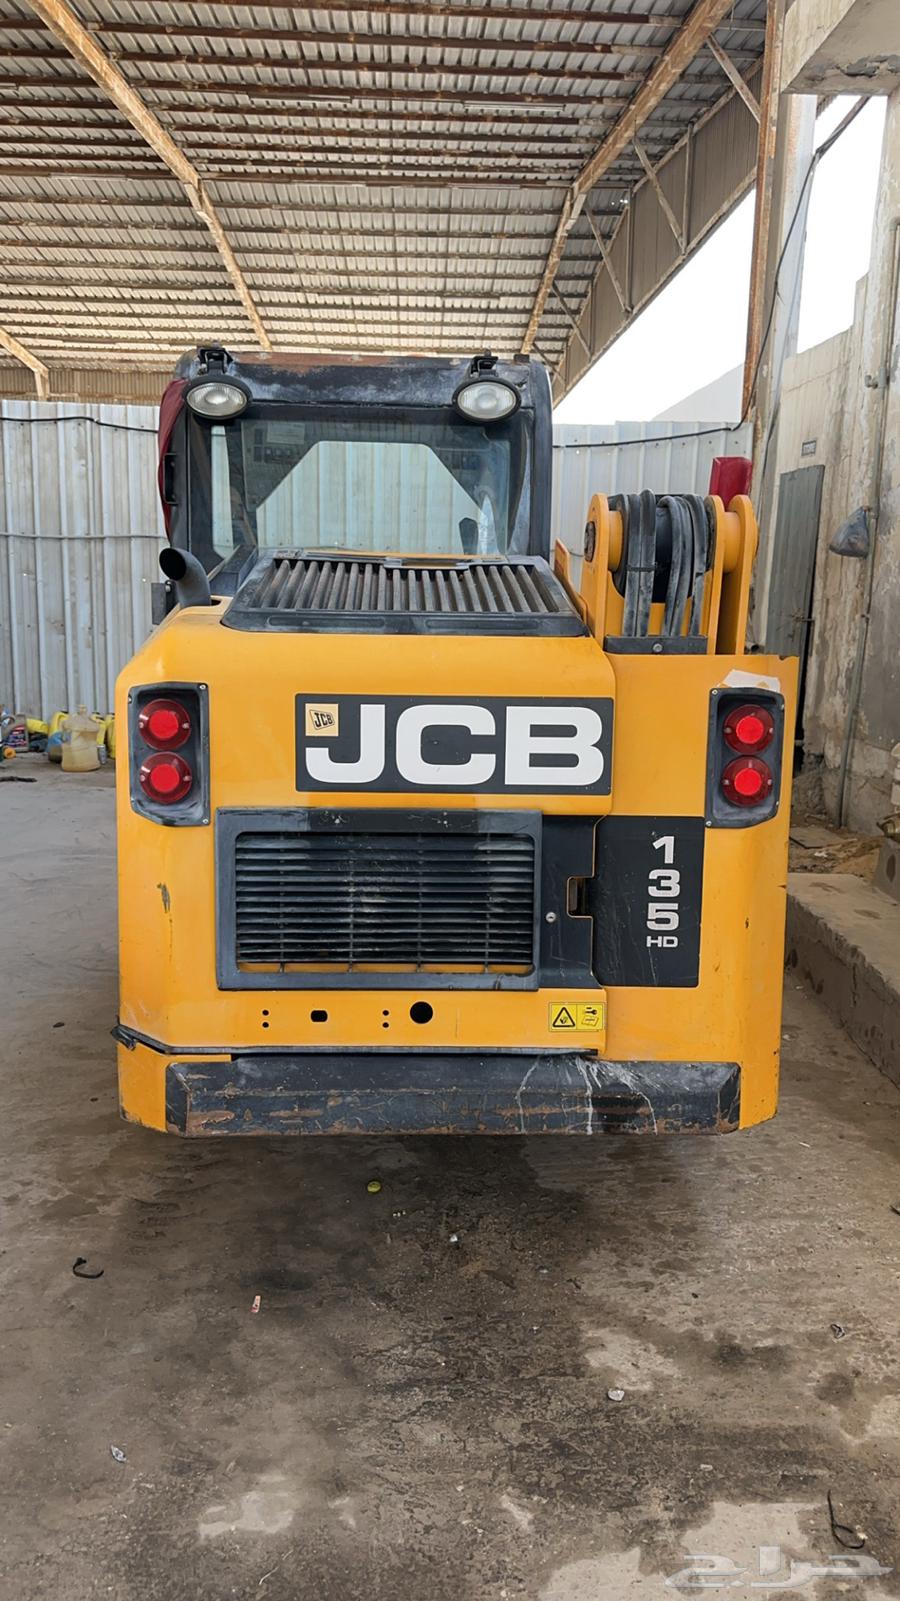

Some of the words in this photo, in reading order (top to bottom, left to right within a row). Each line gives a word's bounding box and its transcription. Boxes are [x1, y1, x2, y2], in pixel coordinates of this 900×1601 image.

[314, 712, 333, 728] JCB
[305, 704, 605, 785] JCB
[646, 836, 680, 931] 135
[646, 935, 678, 948] HD
